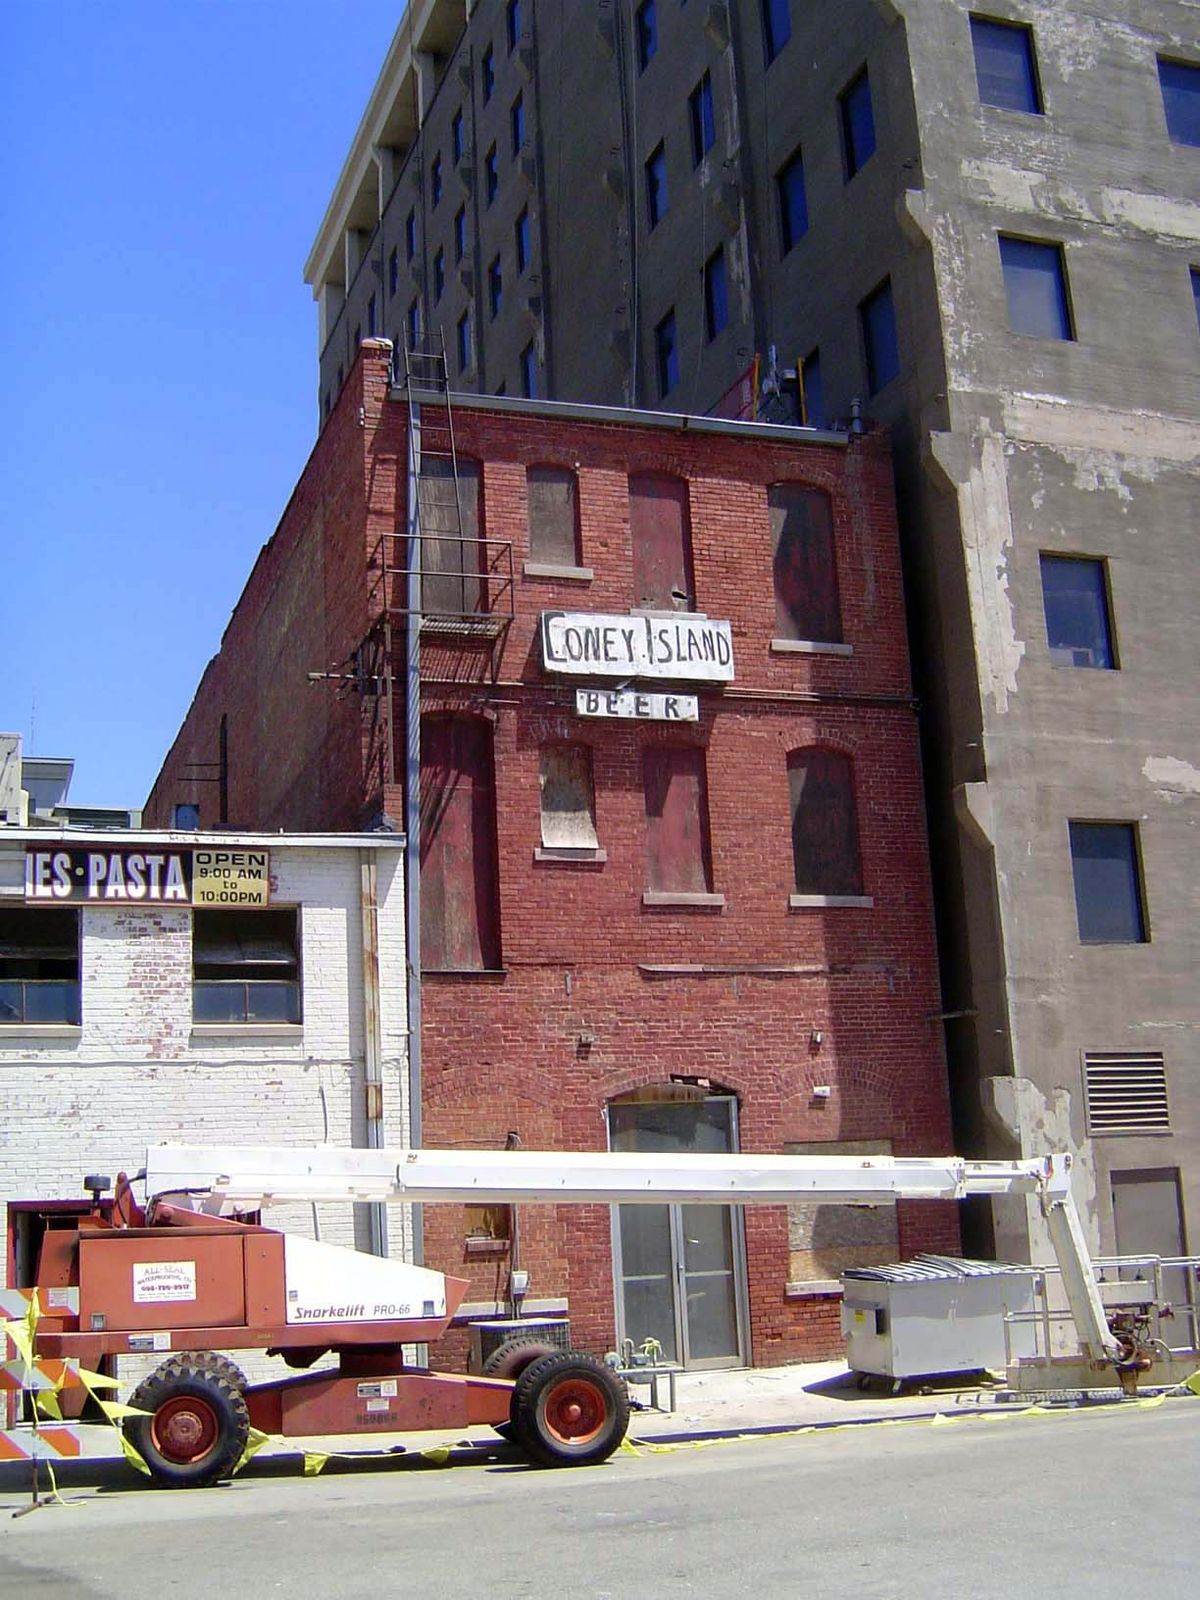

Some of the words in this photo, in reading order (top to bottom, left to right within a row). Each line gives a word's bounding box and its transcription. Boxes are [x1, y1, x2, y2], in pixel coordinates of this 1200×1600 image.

[543, 612, 635, 663] CONEY
[644, 616, 731, 666] ISLAND
[585, 692, 681, 718] BEER
[196, 852, 265, 866] OPEN
[88, 853, 189, 899] PASTA
[199, 867, 231, 879] 9:00
[237, 868, 262, 879] AM
[223, 880, 238, 890] to
[373, 1303, 411, 1316] PRO-66
